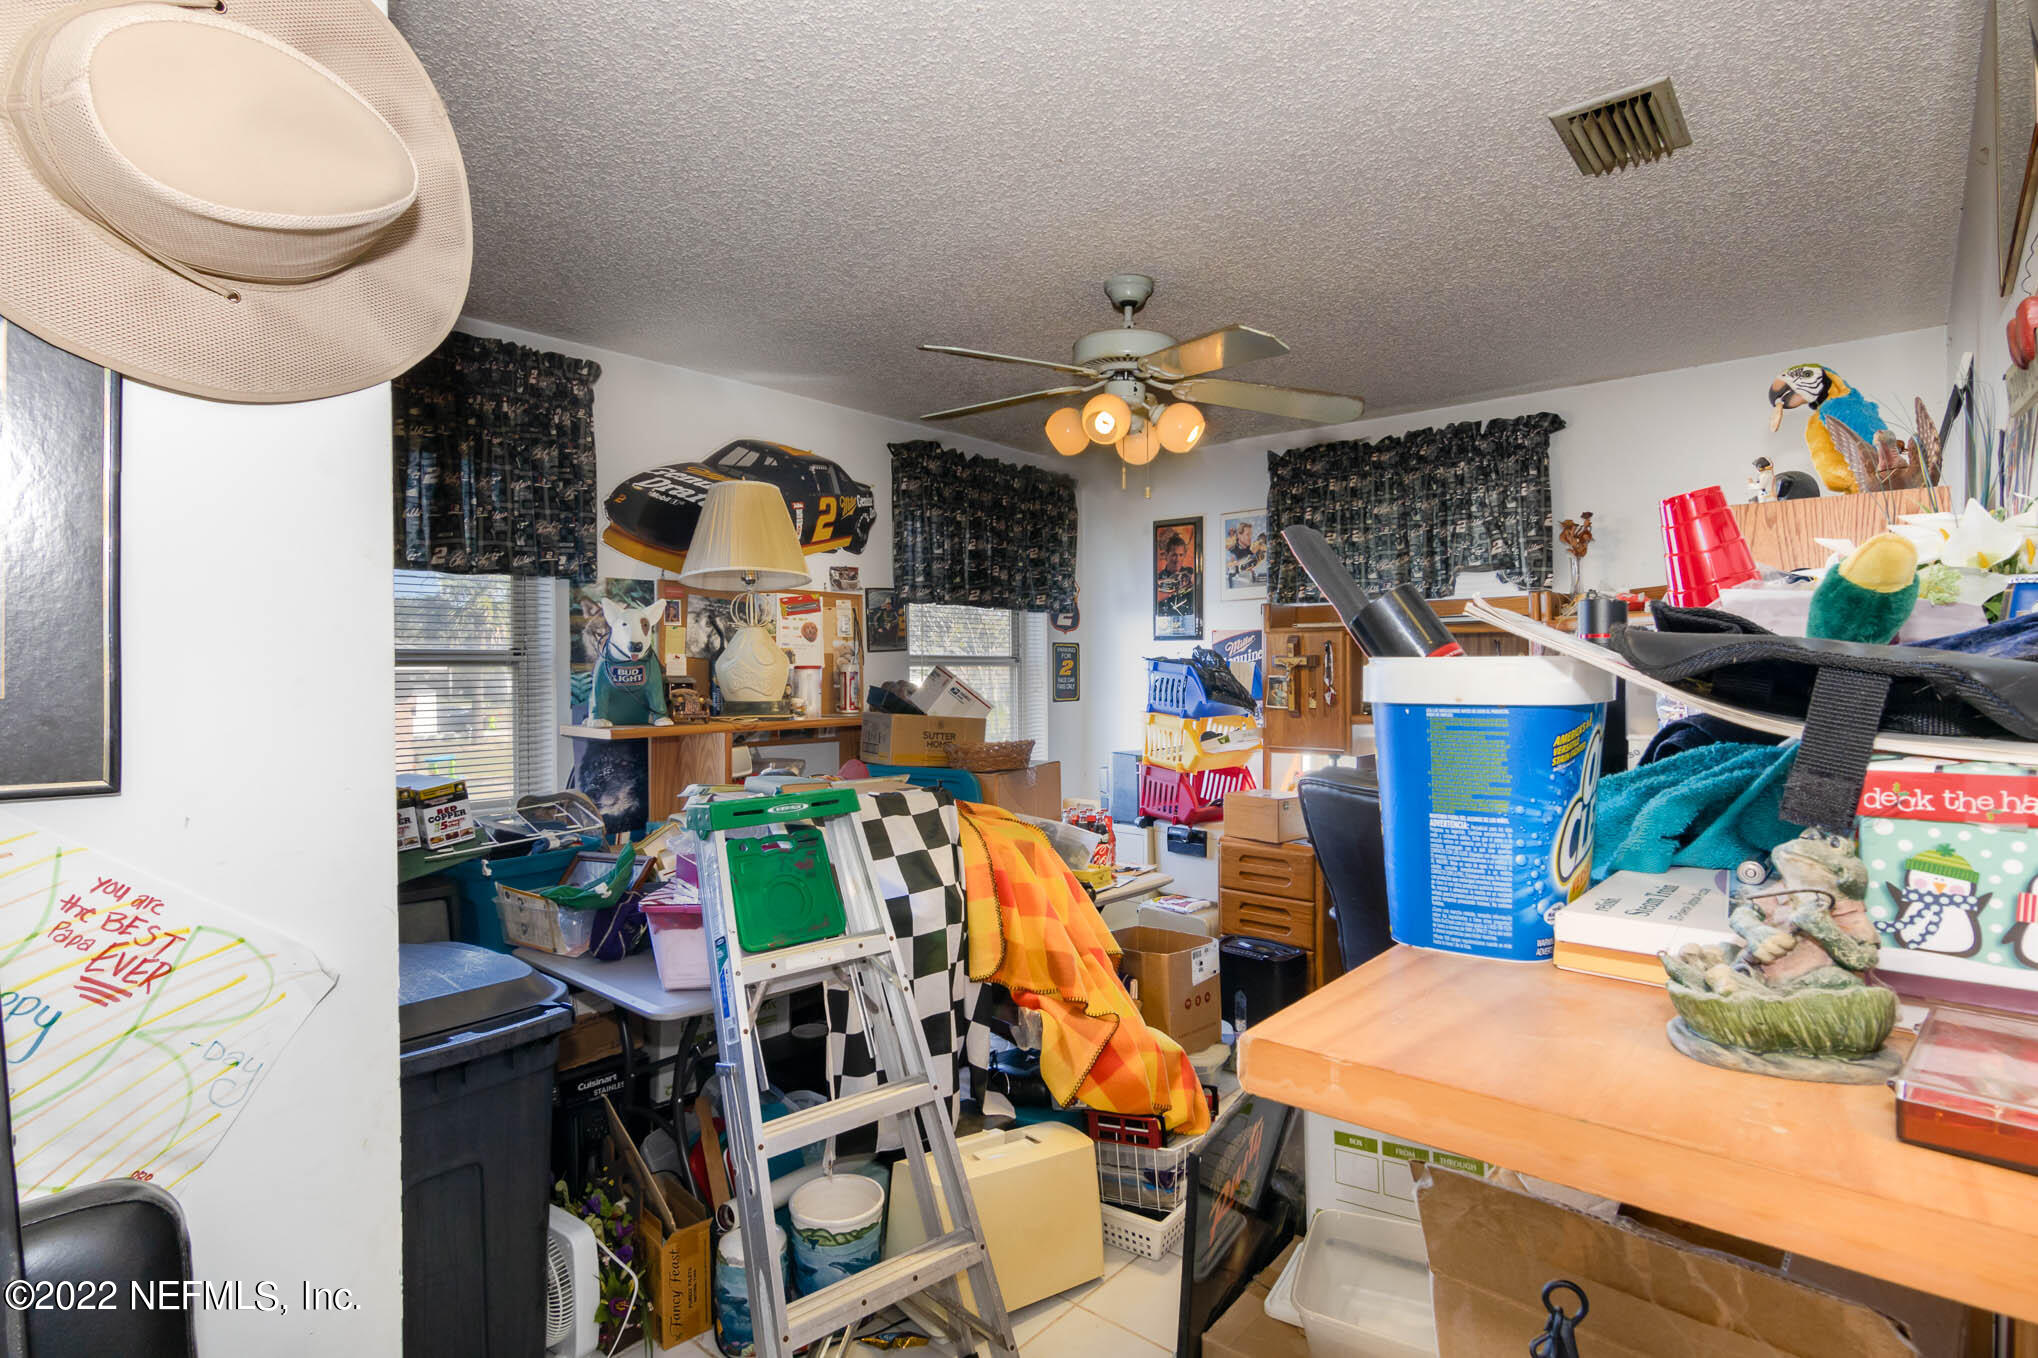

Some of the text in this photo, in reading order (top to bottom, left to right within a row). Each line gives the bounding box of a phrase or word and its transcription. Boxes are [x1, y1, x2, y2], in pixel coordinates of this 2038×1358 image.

[811, 496, 837, 543] 2
[617, 668, 640, 676] BUD
[1059, 660, 1074, 676] 2
[923, 731, 956, 740] SUTTER
[436, 805, 458, 815] RED
[1942, 789, 1994, 814] the
[428, 809, 467, 824] COPPER
[130, 894, 165, 916] are
[60, 893, 187, 958] the BEST
[47, 920, 96, 951] Papa
[84, 941, 173, 995] EVER
[577, 1073, 617, 1091] Cuisinart
[1349, 1137, 1363, 1148] BOX
[1395, 1147, 1416, 1159] FROM
[1440, 1157, 1477, 1172] THROUGH
[669, 1289, 683, 1337] Fancy
